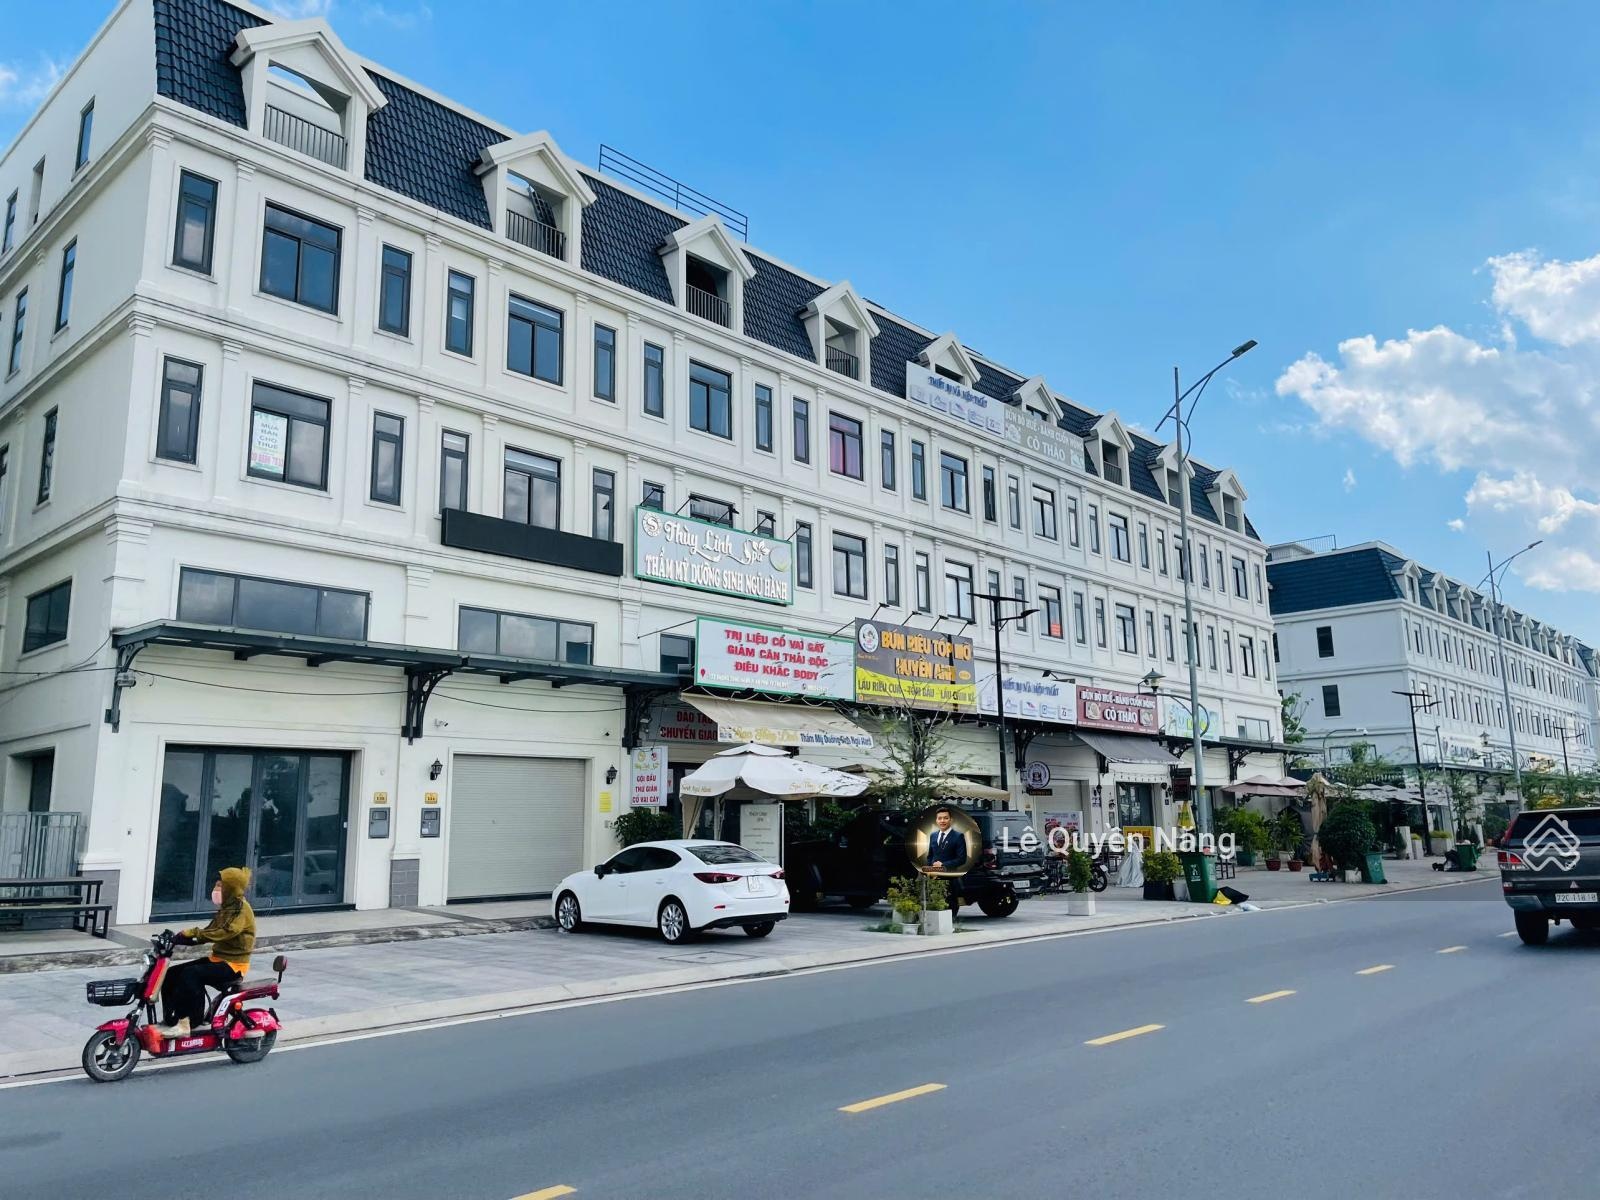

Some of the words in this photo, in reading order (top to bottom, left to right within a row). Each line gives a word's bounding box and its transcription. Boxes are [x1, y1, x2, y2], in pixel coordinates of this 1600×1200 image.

[1042, 441, 1066, 461] THẢO
[664, 520, 698, 556] Thùy
[702, 529, 733, 557] Linh
[645, 546, 673, 580] THẨM
[675, 557, 690, 583] MỸ
[690, 561, 721, 588] DƯỠNG
[722, 569, 744, 593] SINH
[745, 571, 763, 596] NGŨ
[763, 574, 788, 600] HÀNH
[724, 629, 742, 643] TRỊ
[746, 632, 768, 645] LIỆU
[788, 639, 804, 650] VAI
[807, 641, 825, 653] GÁY
[881, 629, 905, 651] BÚN
[907, 633, 931, 655] RIÊU
[932, 636, 953, 658] TÓP
[727, 643, 755, 657] GIẢM
[759, 648, 780, 661] CÂN
[808, 656, 829, 668] ĐỘC
[895, 655, 933, 679] HUYỀN
[763, 663, 790, 677] KHẮC
[793, 669, 819, 681] BODY
[1103, 706, 1117, 721] CÔ
[1117, 707, 1138, 723] THẢO
[660, 724, 696, 740] CHUYỂN
[698, 729, 718, 741] GIAO
